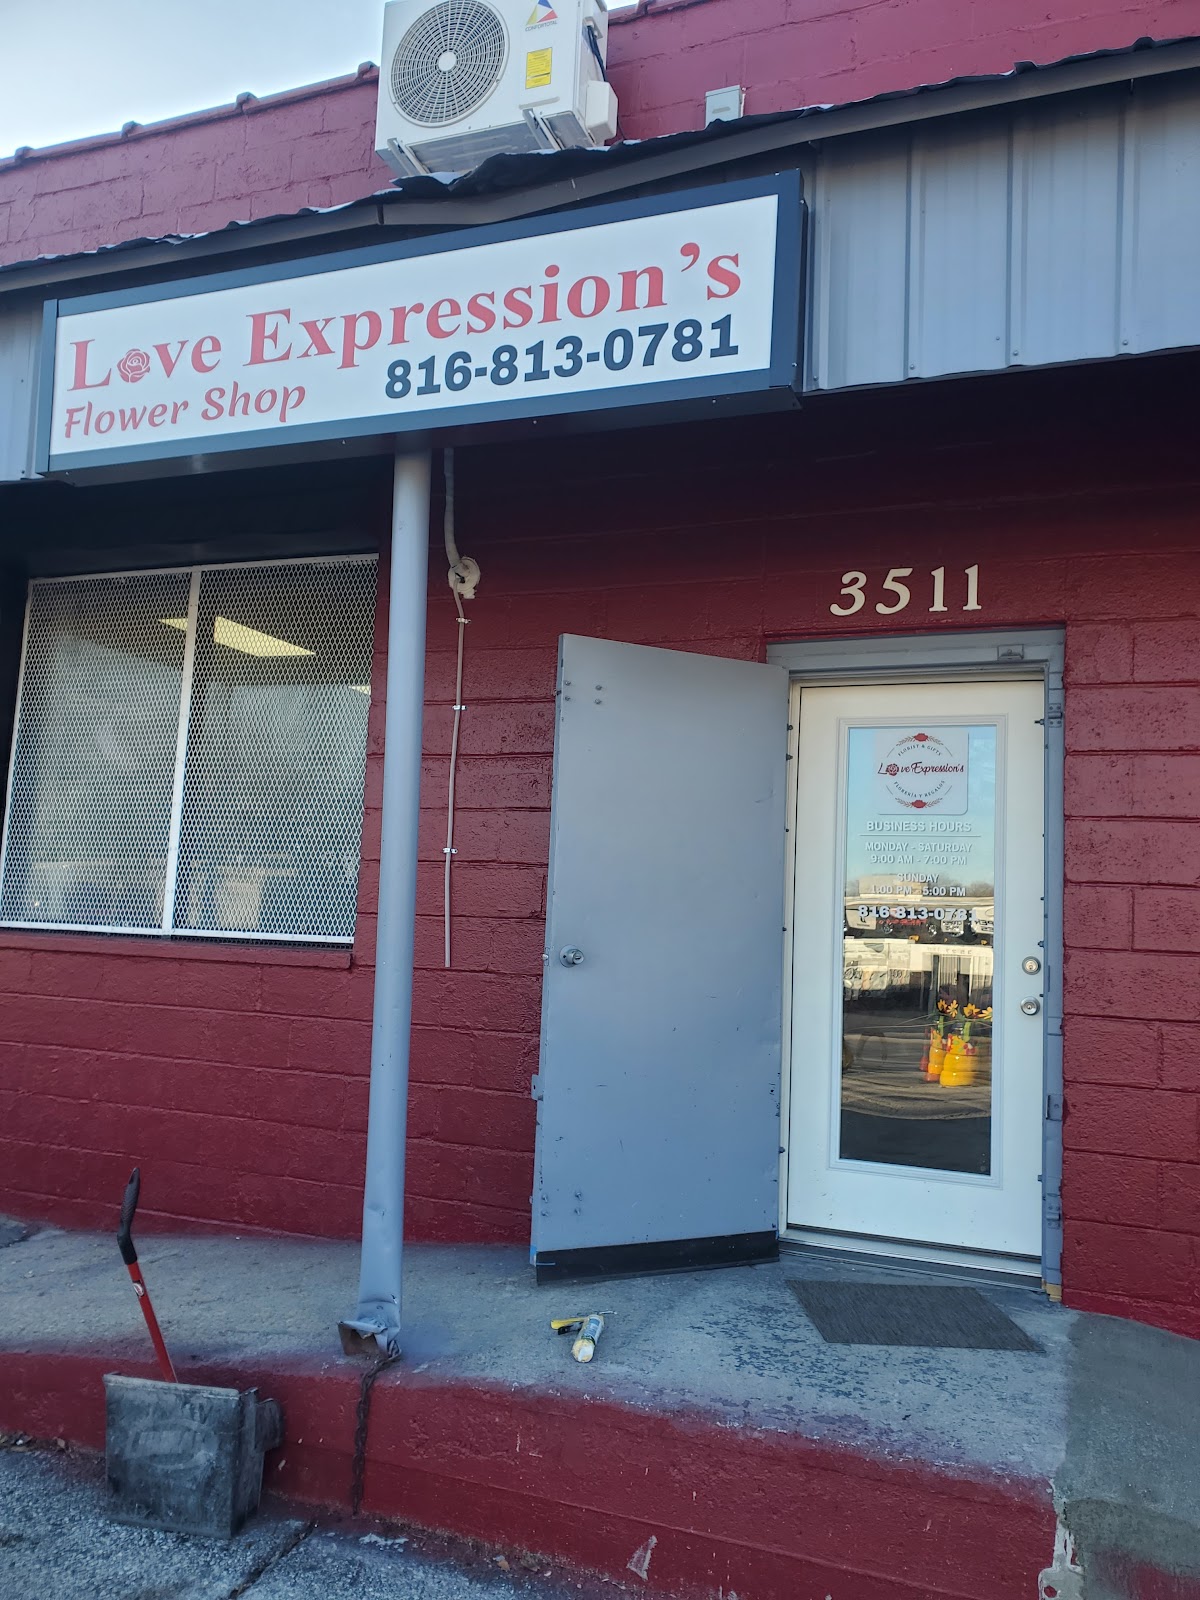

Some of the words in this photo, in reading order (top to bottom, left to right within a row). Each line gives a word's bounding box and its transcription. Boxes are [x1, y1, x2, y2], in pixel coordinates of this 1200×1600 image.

[242, 242, 741, 370] Expression's
[385, 313, 739, 400] 816-813-0781
[64, 400, 189, 438] Flower
[201, 381, 306, 423] Shop
[829, 564, 982, 616] 3511
[898, 744, 920, 757] FLORIST
[927, 745, 942, 756] GIFTS
[924, 780, 945, 797] REGALOS
[866, 821, 926, 832] BUSINESS
[929, 821, 972, 832] HOURS
[865, 842, 909, 852] MONDAY
[919, 842, 972, 853] SATURDAY
[870, 854, 895, 864] 9:00
[898, 855, 914, 864] AM
[923, 855, 947, 865] 7:00
[950, 856, 968, 865] PM
[897, 873, 939, 883] SUNDAY
[896, 885, 912, 895] PM
[922, 886, 946, 896] 5:00
[949, 886, 966, 896] PM
